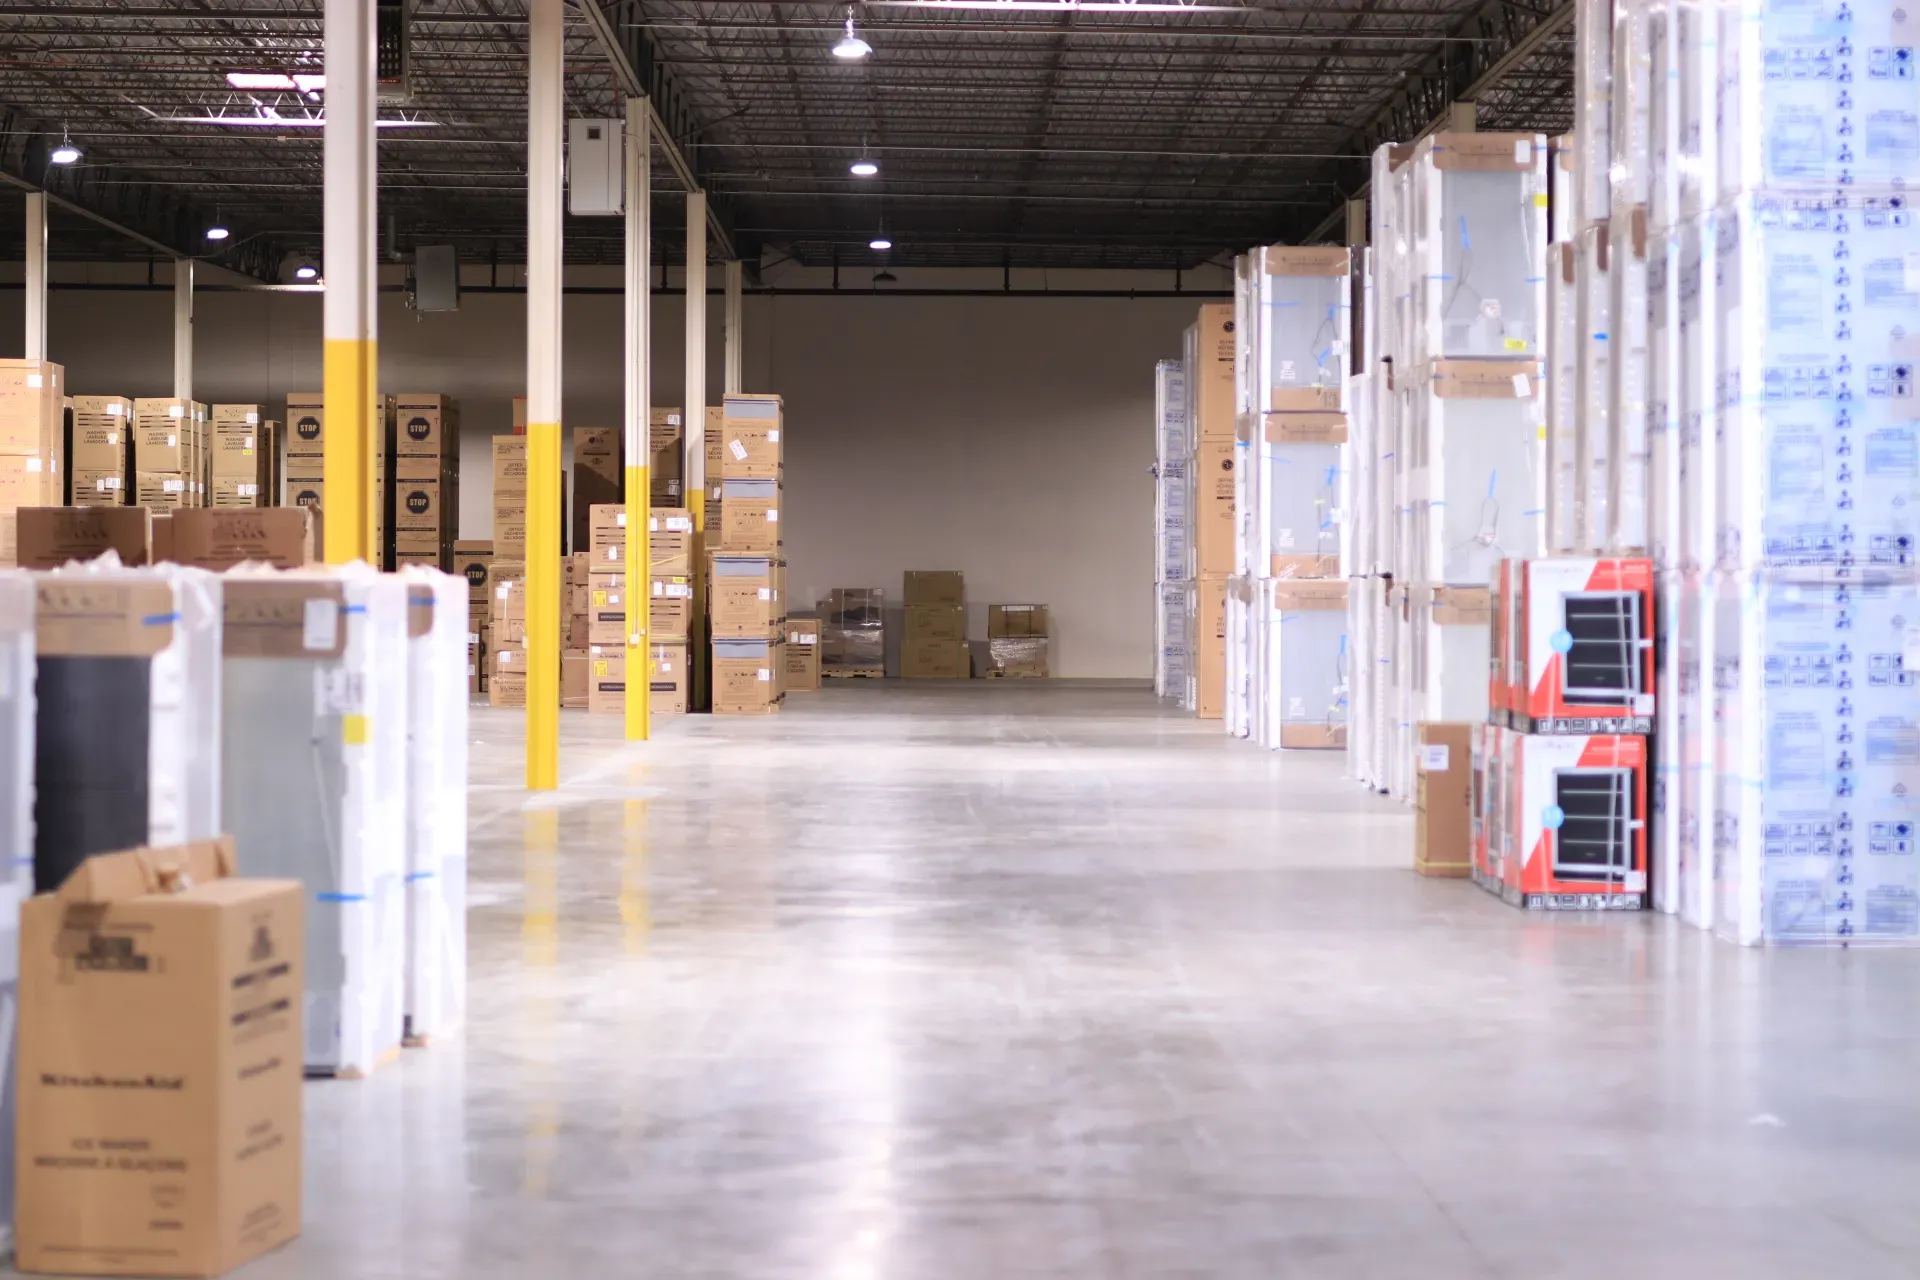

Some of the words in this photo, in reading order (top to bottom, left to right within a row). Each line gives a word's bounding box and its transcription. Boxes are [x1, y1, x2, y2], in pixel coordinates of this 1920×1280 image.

[300, 424, 317, 432] STOP
[410, 424, 427, 432] STOP
[409, 498, 427, 506] STOP
